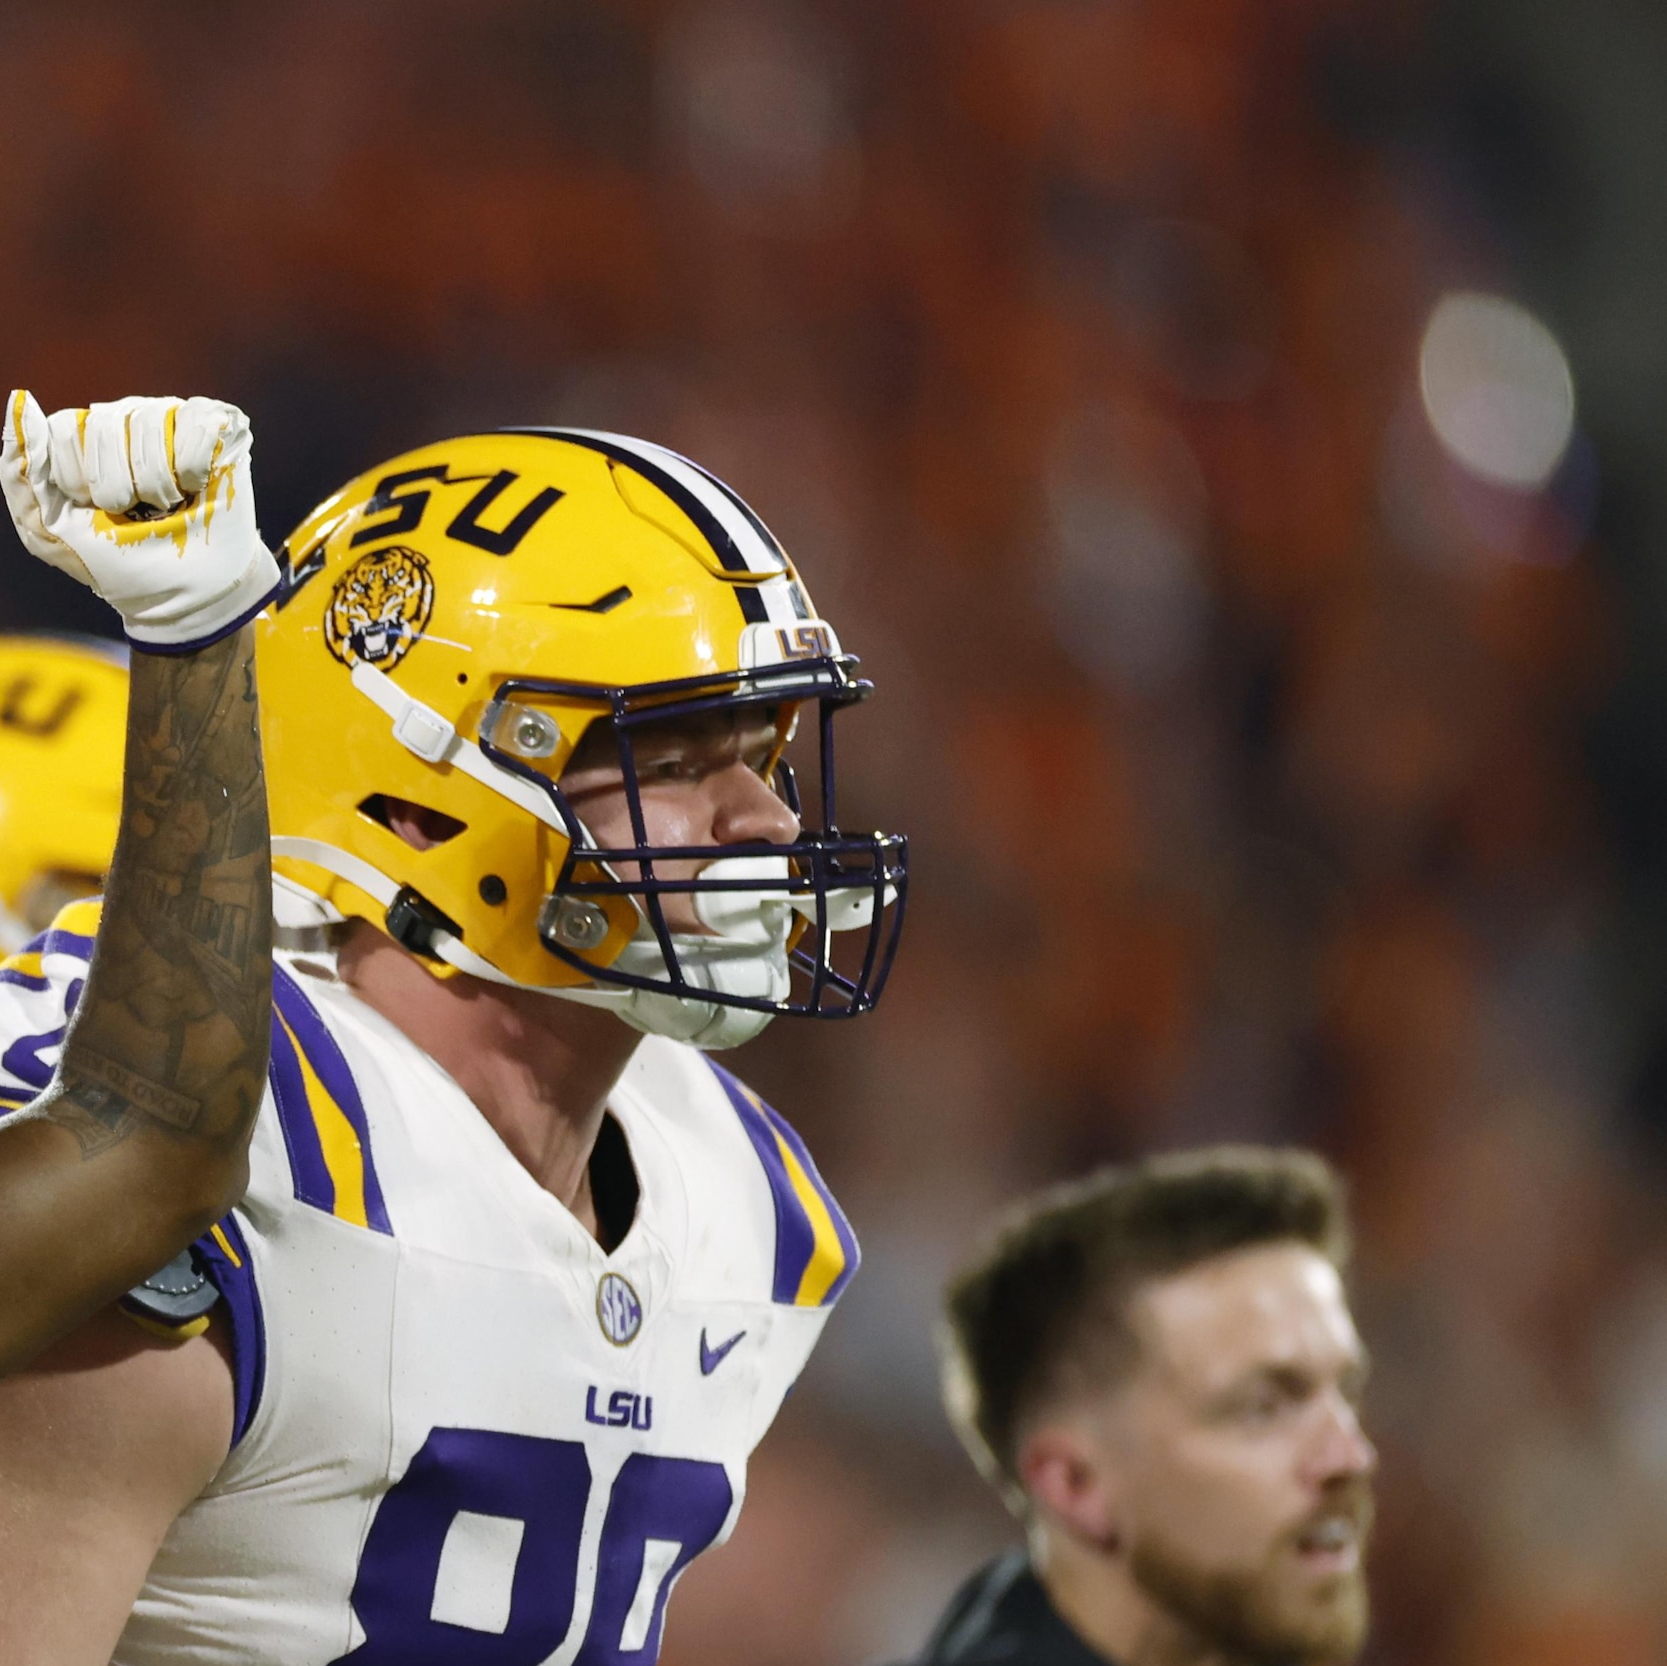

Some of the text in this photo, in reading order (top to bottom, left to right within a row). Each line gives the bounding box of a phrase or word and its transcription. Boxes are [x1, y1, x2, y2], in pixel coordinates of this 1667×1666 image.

[775, 626, 832, 660] LSU
[600, 1273, 641, 1344] SEC
[585, 1385, 652, 1431] LSU
